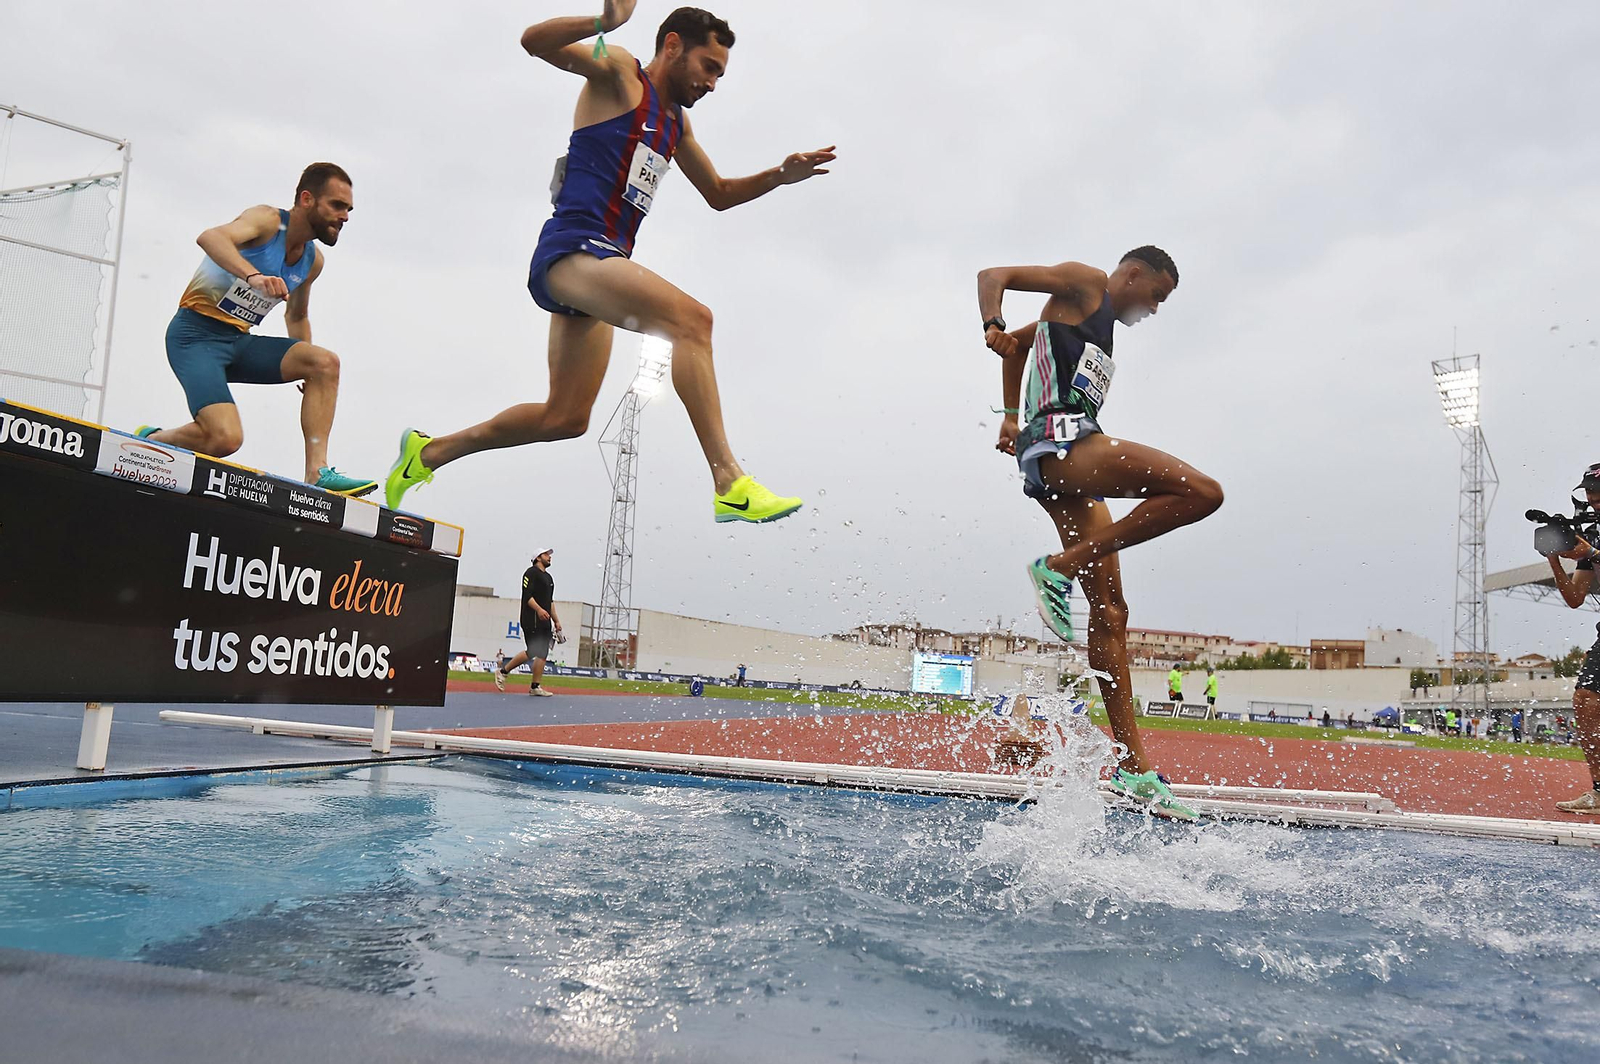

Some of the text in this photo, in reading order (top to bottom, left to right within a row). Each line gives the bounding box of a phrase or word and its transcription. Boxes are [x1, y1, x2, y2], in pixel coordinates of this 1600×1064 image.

[234, 286, 272, 309] MARTOS
[118, 455, 147, 468] Continental
[229, 473, 274, 494] DIPUTACIÓN
[227, 485, 268, 504] DE HUELVA
[289, 489, 314, 506] Huelva
[288, 504, 300, 516] tus
[182, 532, 405, 617] Huelva eleva
[172, 618, 395, 680] tus sentidos.
